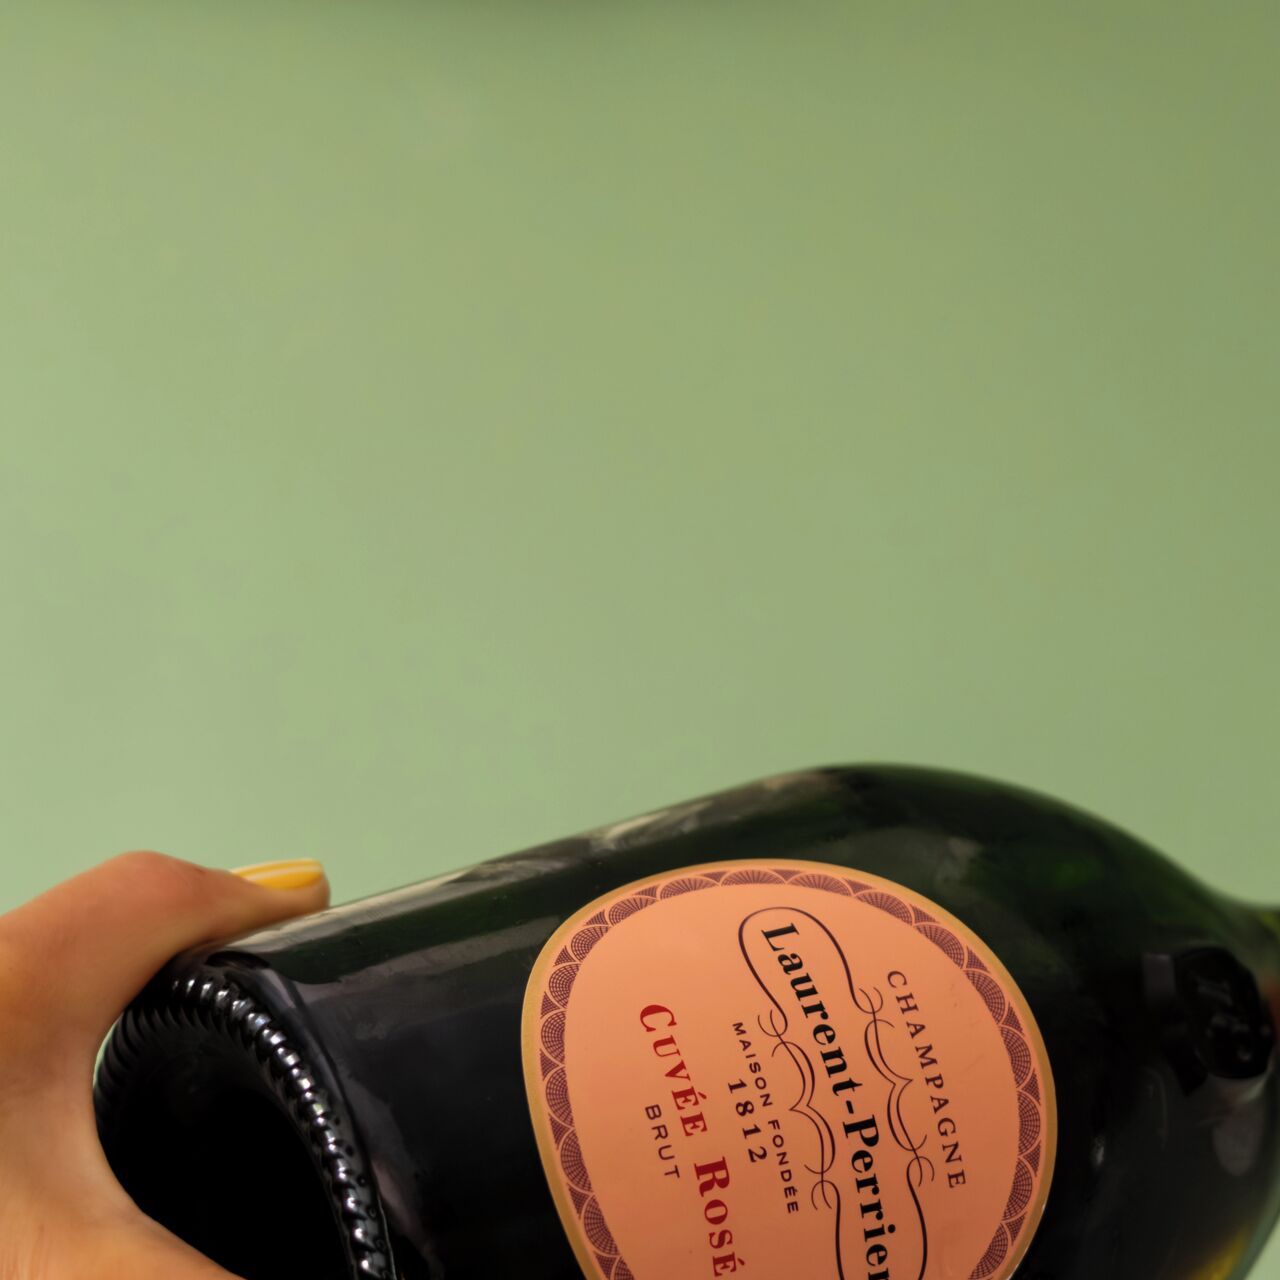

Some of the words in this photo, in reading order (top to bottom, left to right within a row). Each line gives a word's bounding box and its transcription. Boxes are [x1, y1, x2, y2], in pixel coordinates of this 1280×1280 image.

[644, 1103, 681, 1180] BRUT
[727, 1078, 768, 1163] 1812
[731, 1021, 774, 1108] MAISON
[767, 1118, 800, 1214] FONDÉE
[886, 970, 967, 1189] CHAMPAGNE
